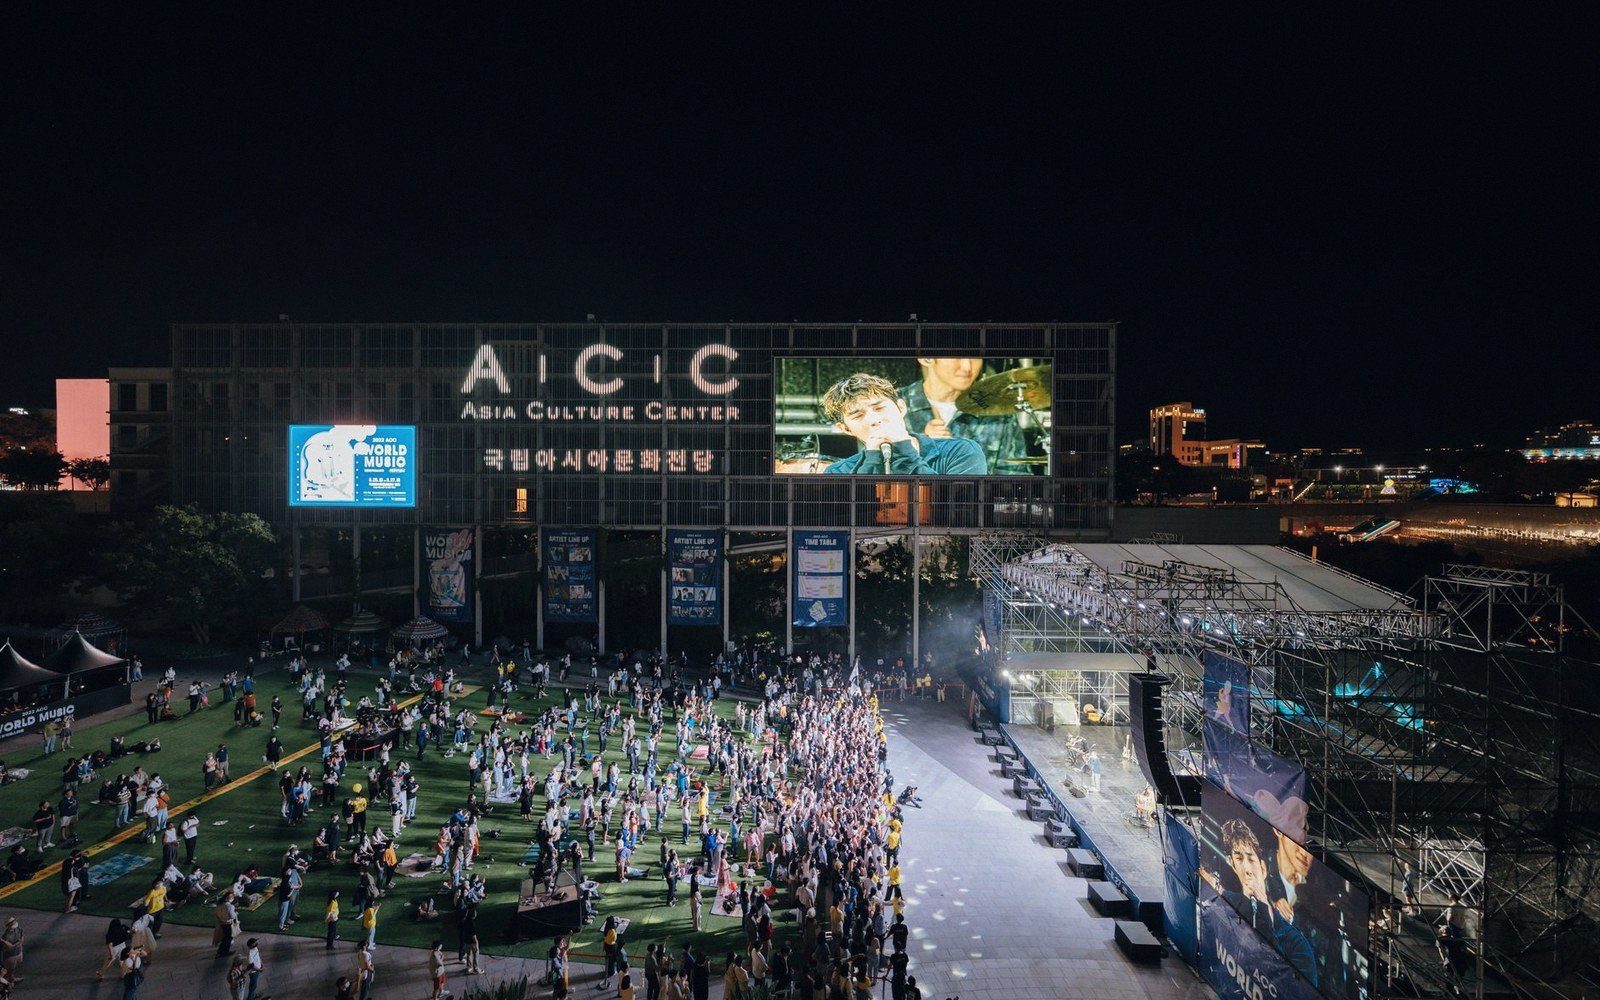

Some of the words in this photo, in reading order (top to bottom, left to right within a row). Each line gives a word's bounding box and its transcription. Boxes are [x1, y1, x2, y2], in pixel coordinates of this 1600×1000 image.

[364, 456, 406, 468] MUSIC
[483, 448, 715, 472] 국립아시아문화전당
[39, 704, 75, 722] MUSIC
[1216, 937, 1264, 1000] WORLD
